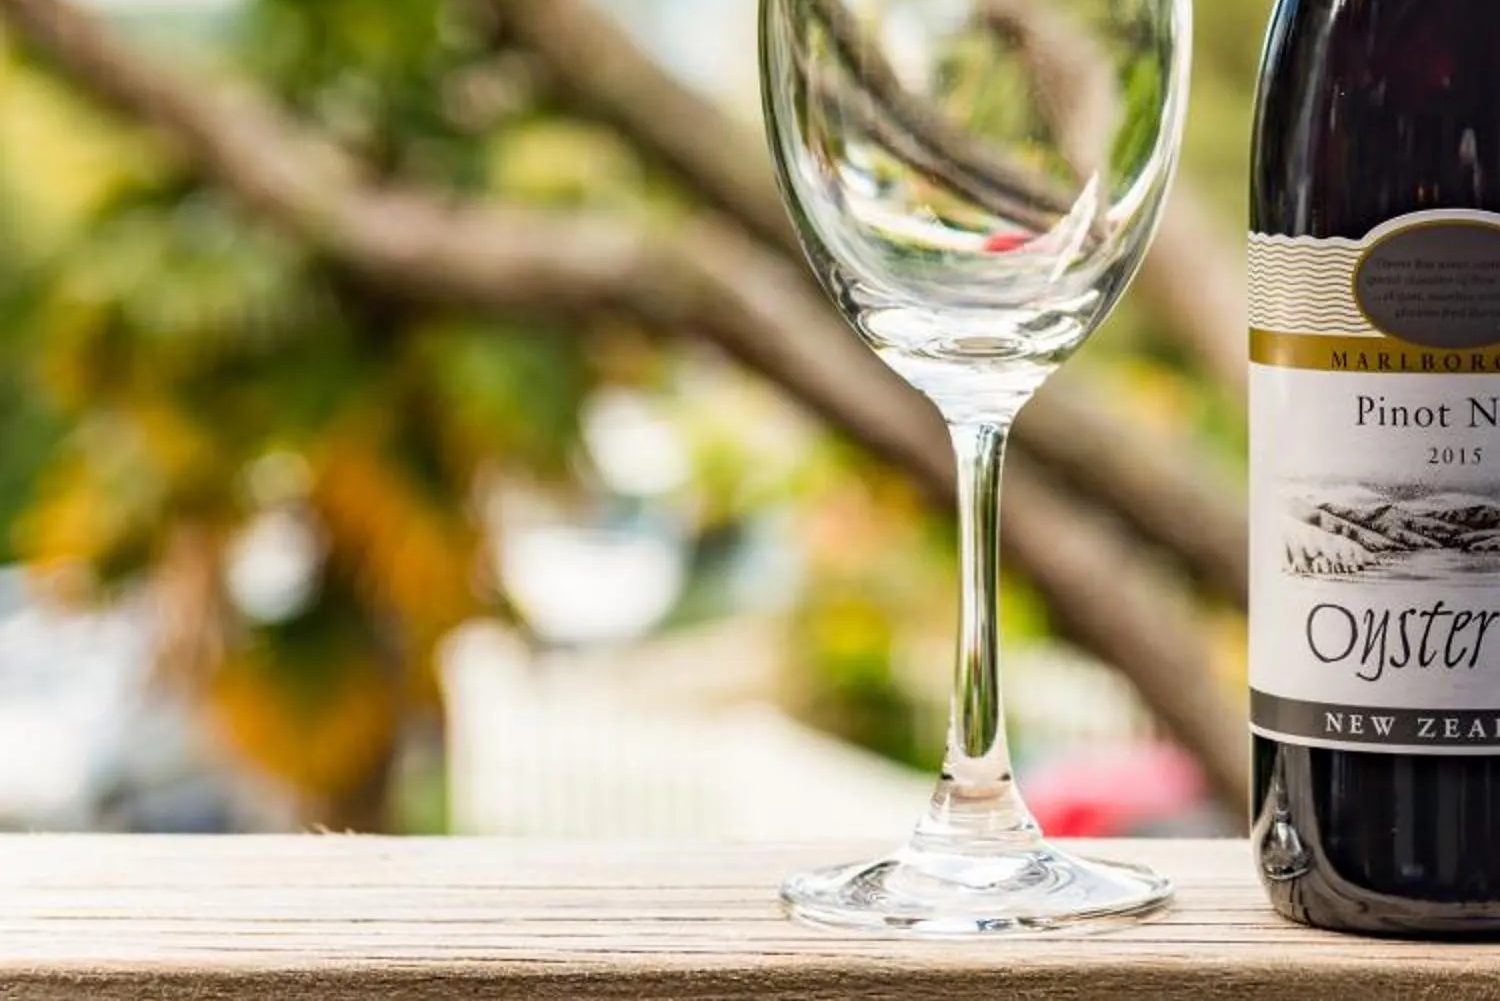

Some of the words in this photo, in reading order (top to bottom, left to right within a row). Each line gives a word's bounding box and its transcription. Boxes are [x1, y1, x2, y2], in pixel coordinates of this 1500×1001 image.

[1355, 395, 1450, 428] Pinot
[1428, 447, 1483, 465] 2015
[1305, 600, 1500, 681] Oyster
[1325, 712, 1396, 736] NEW
